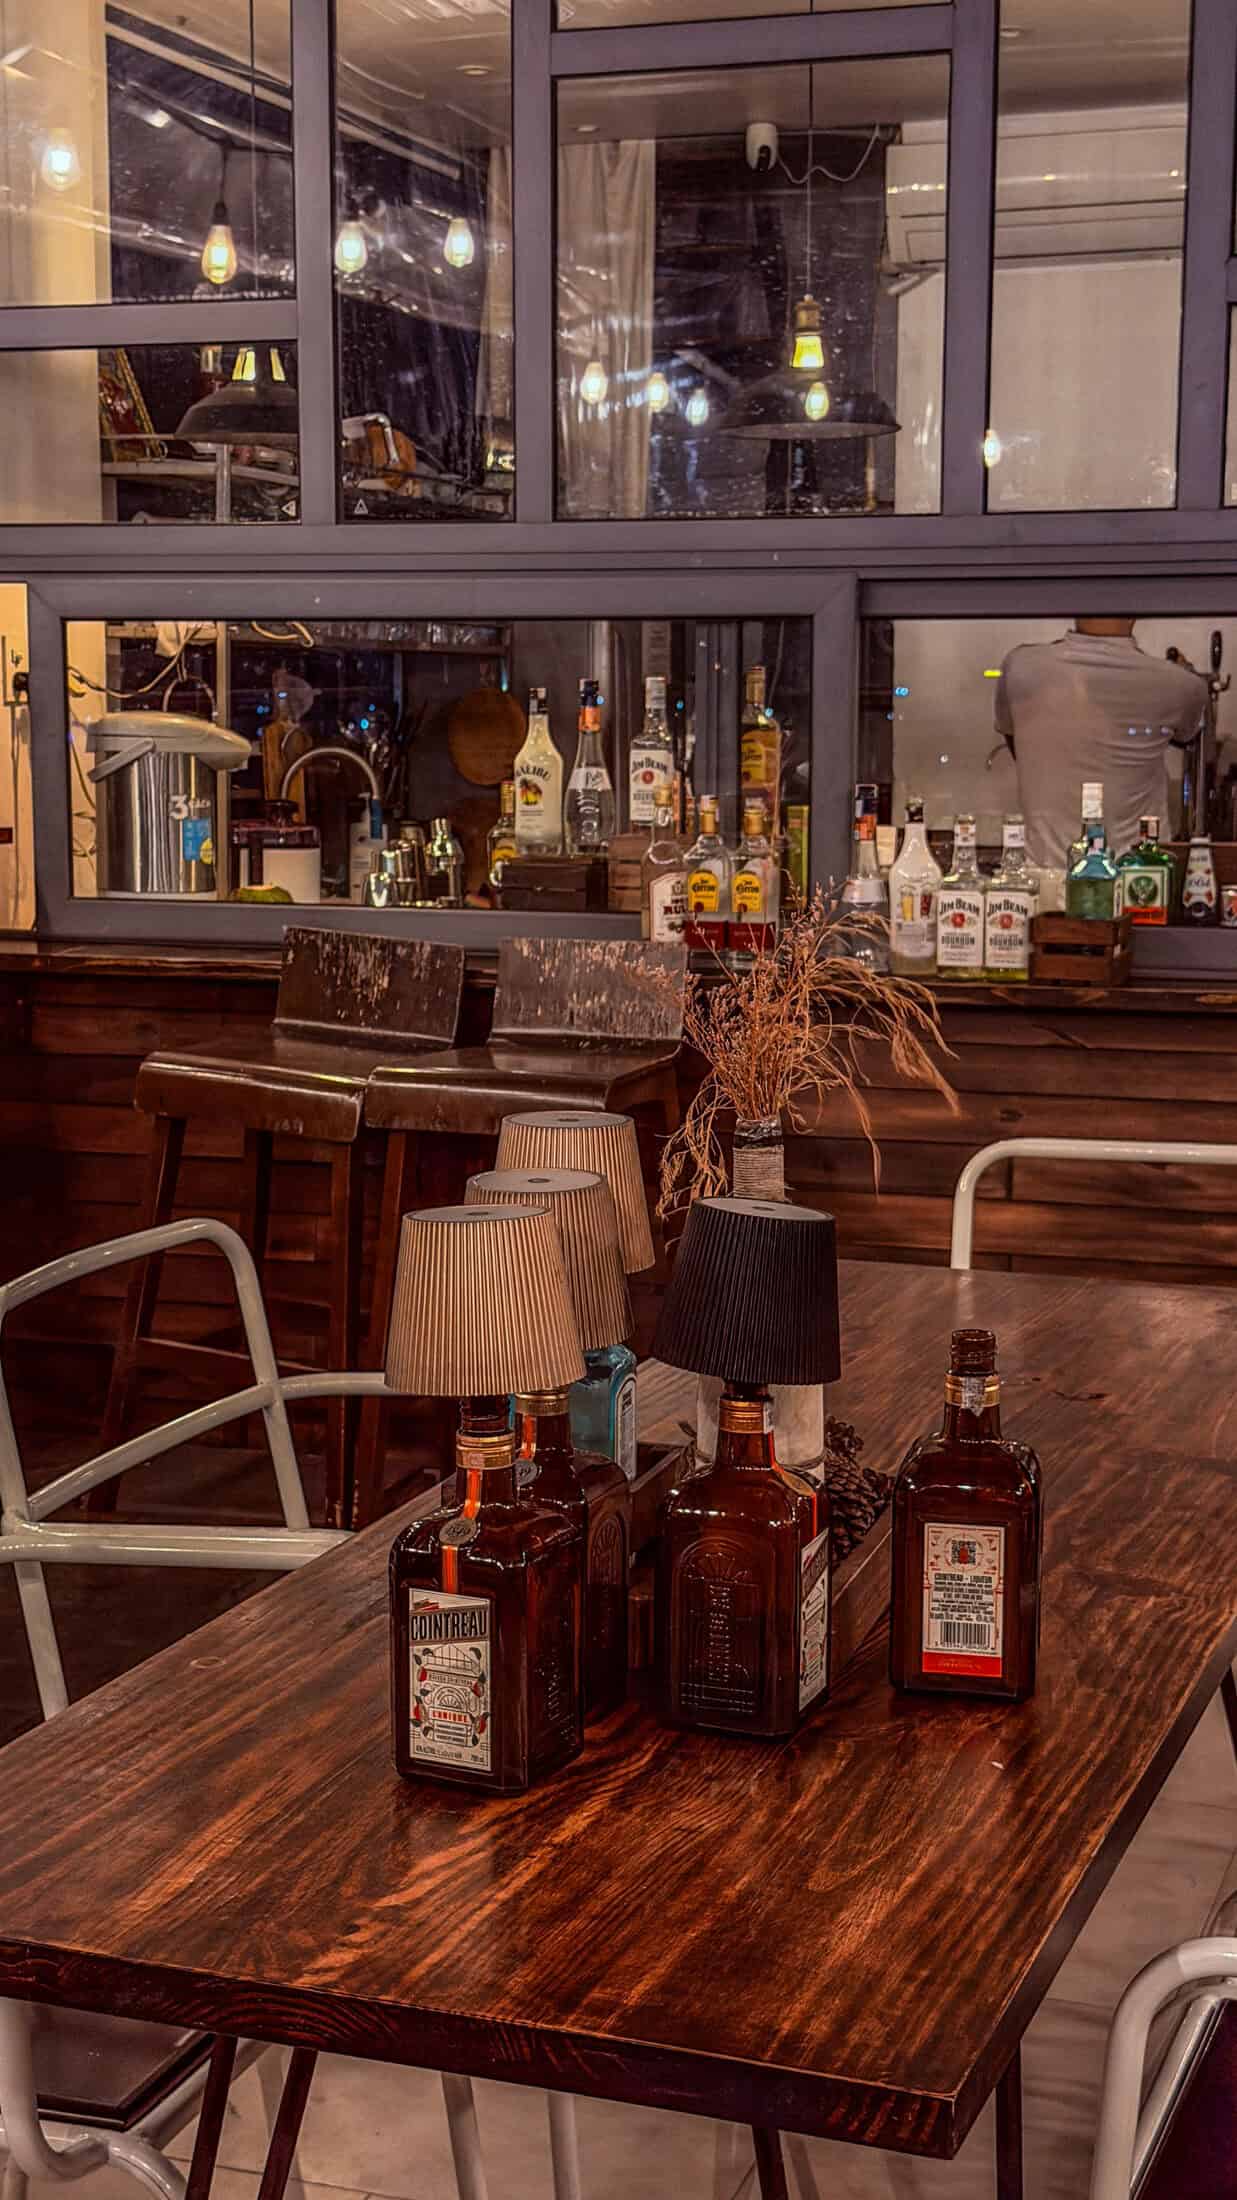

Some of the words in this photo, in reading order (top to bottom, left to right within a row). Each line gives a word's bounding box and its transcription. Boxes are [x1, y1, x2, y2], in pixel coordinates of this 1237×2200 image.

[940, 901, 955, 915] JIM
[956, 898, 980, 916] BEAM
[987, 903, 1002, 917] JIM
[1003, 899, 1028, 916] BEAM
[411, 1610, 487, 1641] COINTREAU
